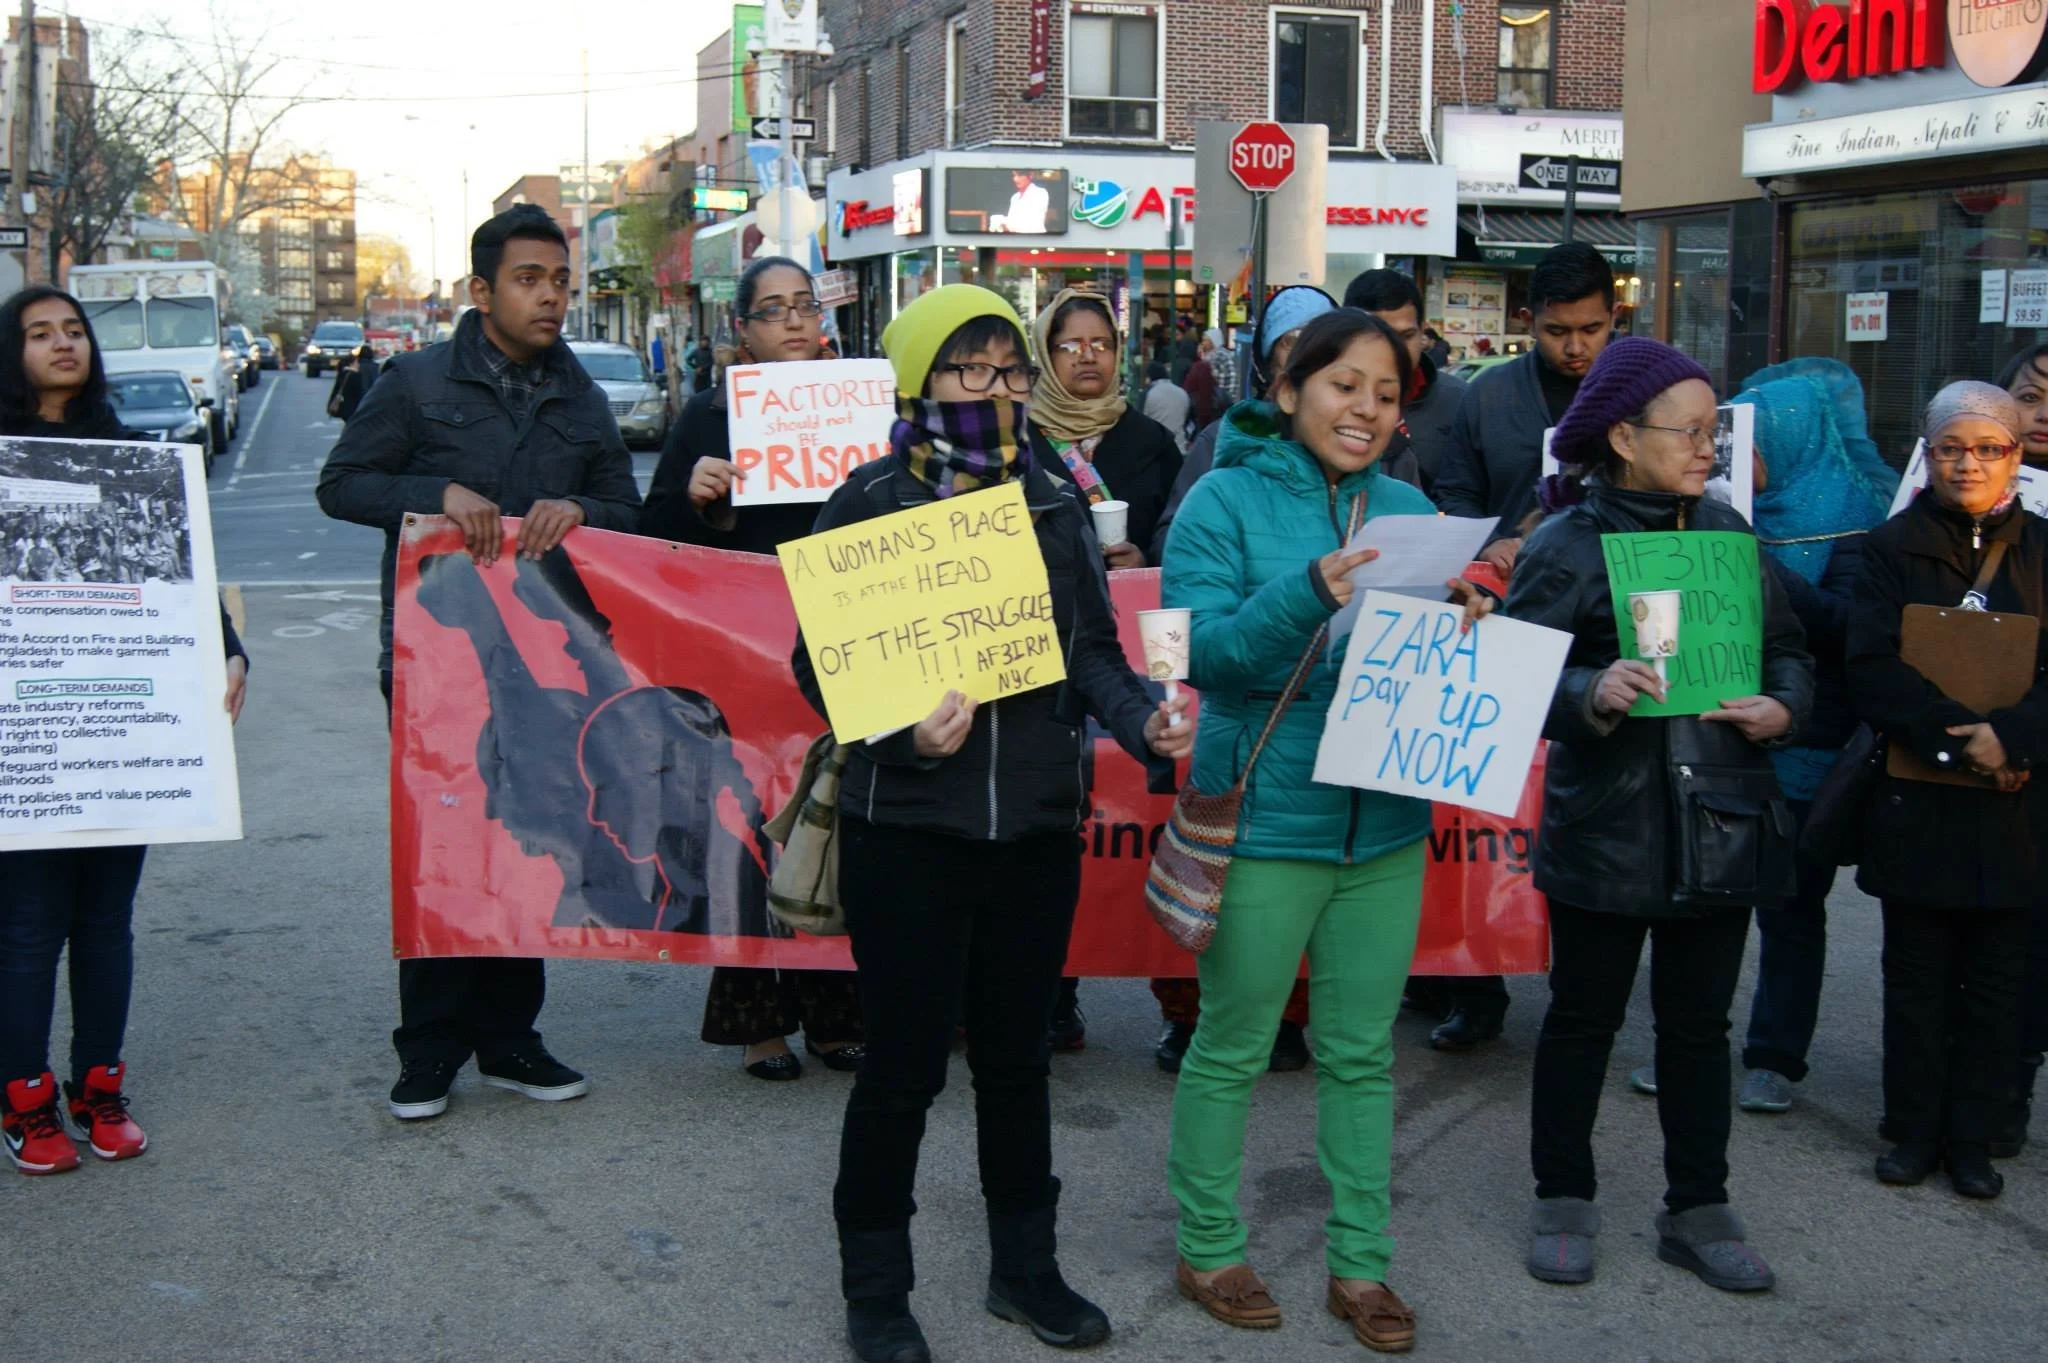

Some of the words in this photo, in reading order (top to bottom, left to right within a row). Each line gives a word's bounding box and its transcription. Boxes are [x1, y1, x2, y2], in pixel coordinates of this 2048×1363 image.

[1092, 3, 1147, 16] ENTRANCE
[1752, 0, 1935, 94] Delhi
[1560, 127, 1619, 145] MERIT
[1787, 133, 1823, 158] Fine
[1835, 127, 1900, 153] Indian,
[1913, 113, 1980, 151] Nepali
[1234, 143, 1293, 169] STOP
[1535, 165, 1566, 181] ONE
[1579, 167, 1611, 182] WAY
[2012, 282, 2048, 297] BUFFET
[2014, 308, 2042, 323] $9.95
[765, 415, 820, 435] should
[825, 413, 853, 426] not
[799, 433, 821, 446] BE
[794, 549, 816, 581] A
[825, 521, 937, 573] WOMAN'S
[949, 502, 1021, 543] PLACE
[832, 591, 852, 608] IS
[916, 556, 991, 593] HEAD
[15, 590, 85, 599] SHORT-TERM
[87, 591, 138, 601] DEMANDS
[17, 605, 107, 618] compensation
[110, 607, 143, 617] owed
[146, 607, 159, 617] to
[22, 633, 69, 644] Accord
[72, 636, 89, 644] on
[92, 633, 116, 644] Fire
[119, 634, 142, 645] and
[146, 635, 195, 647] Building
[819, 640, 857, 676] OF
[867, 617, 937, 661] THE
[942, 591, 1053, 642] STRUGGLE
[61, 647, 74, 656] to
[77, 647, 113, 656] make
[116, 648, 169, 659] garment
[976, 633, 1052, 672] AF3IRM
[1362, 609, 1479, 682] ZARA
[29, 659, 65, 668] safer
[998, 666, 1039, 693] NYC
[20, 684, 90, 695] LONG-TERM
[92, 683, 149, 693] DEMANDS
[25, 700, 84, 713] industry
[88, 699, 145, 711] reforms
[83, 712, 181, 725] accountability,
[6, 729, 41, 742] right
[44, 729, 58, 739] to
[62, 726, 127, 738] collective
[1, 742, 57, 756] gaining)
[0, 760, 57, 774] feguard
[61, 758, 119, 769] workers
[122, 757, 174, 768] welfare
[178, 756, 203, 767] and
[1377, 727, 1498, 796] NOW
[18, 791, 72, 806] policies
[76, 789, 102, 800] and
[106, 788, 142, 800] value
[146, 787, 192, 802] people
[34, 804, 82, 820] profits
